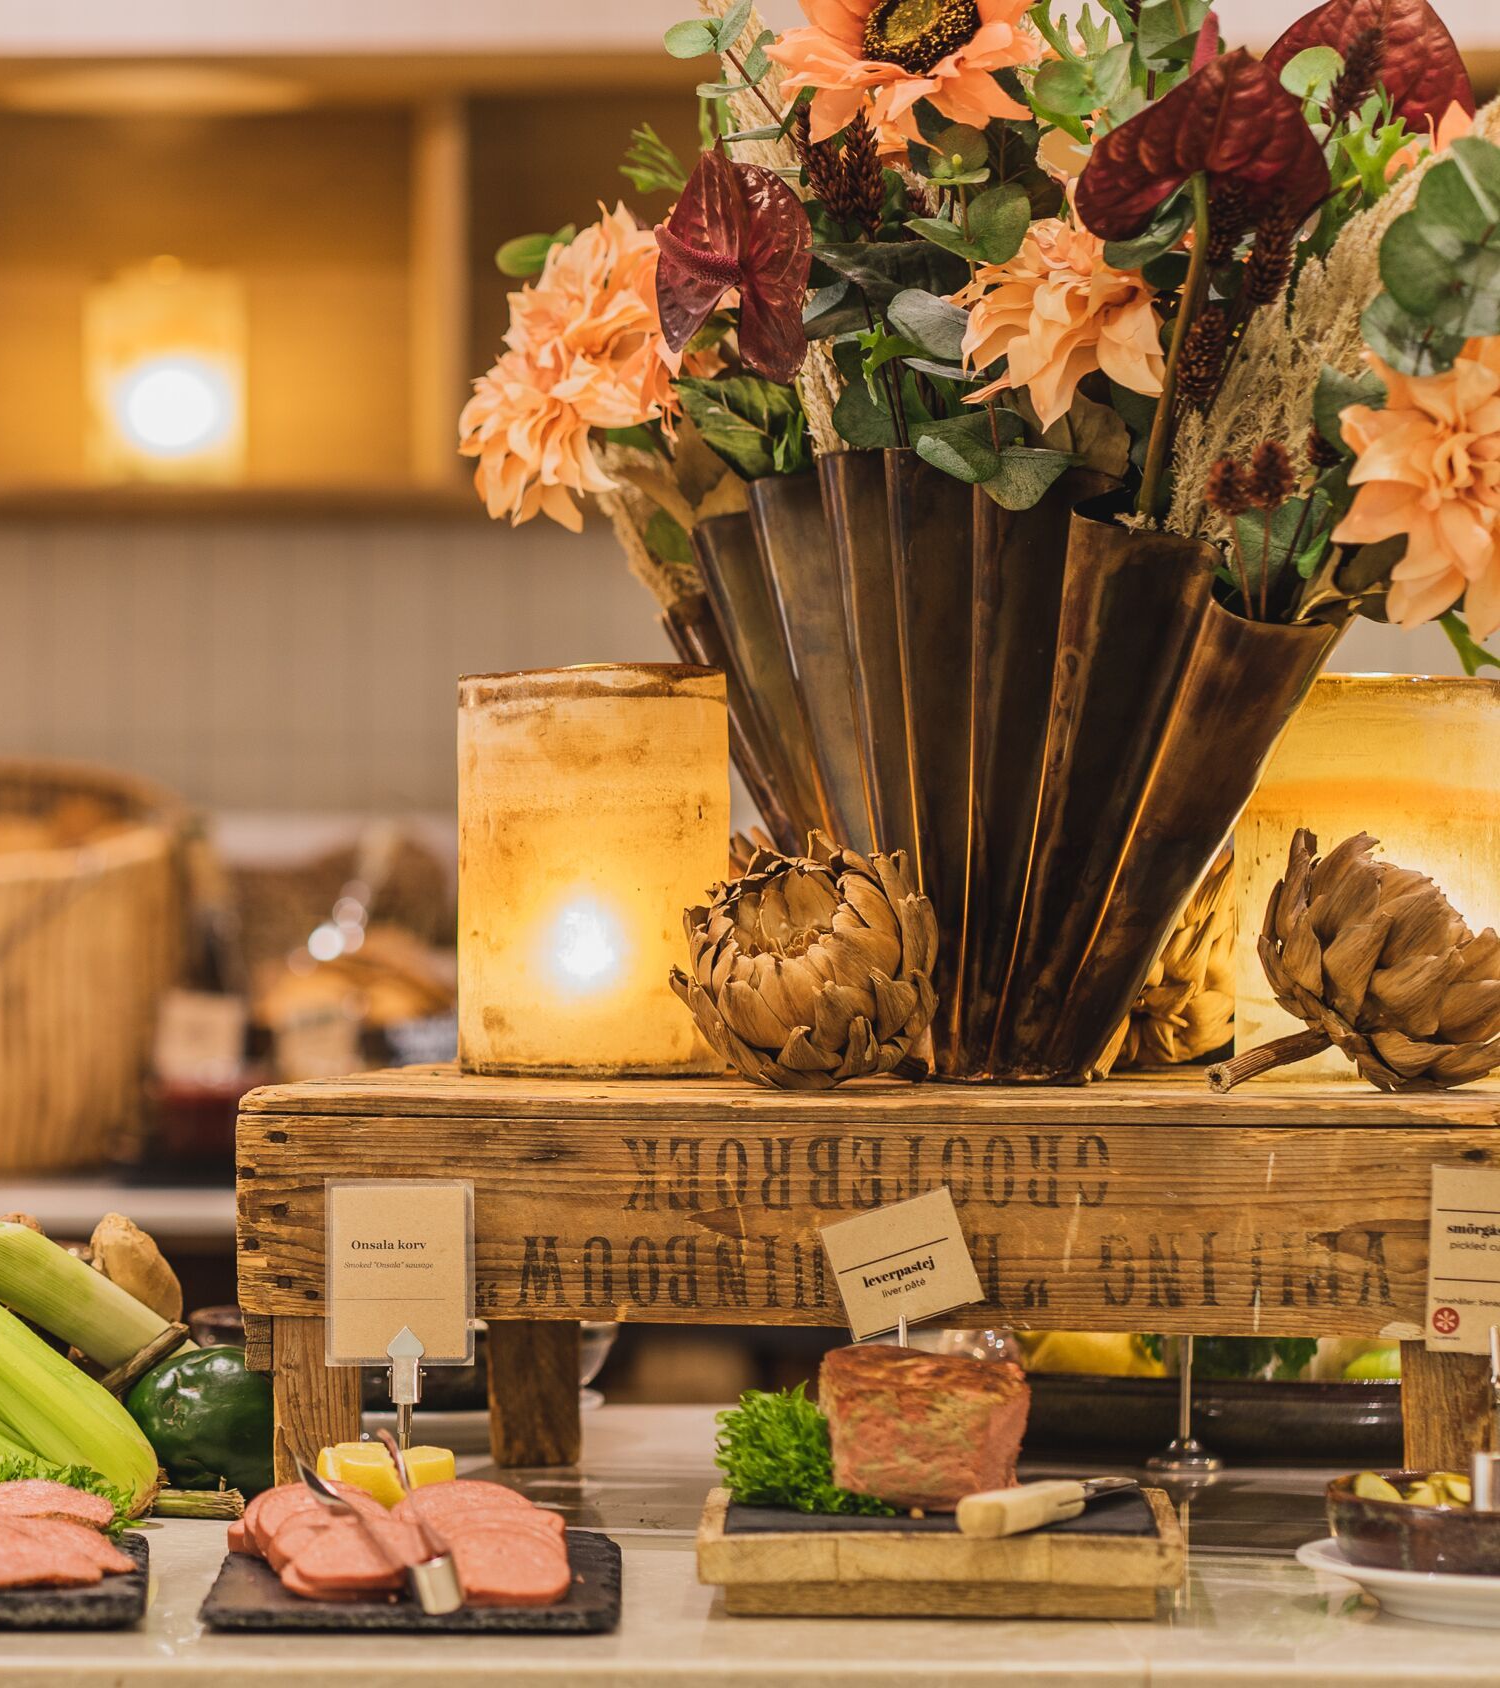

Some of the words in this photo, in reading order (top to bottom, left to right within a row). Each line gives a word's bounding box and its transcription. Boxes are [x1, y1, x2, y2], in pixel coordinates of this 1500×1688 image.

[621, 1135, 1109, 1211] GROOTEBROEK
[351, 1239, 395, 1250] Onsala
[398, 1239, 427, 1250] korv
[862, 1255, 936, 1289] leverpastej
[881, 1286, 903, 1299] liver
[904, 1278, 926, 1292] pâté
